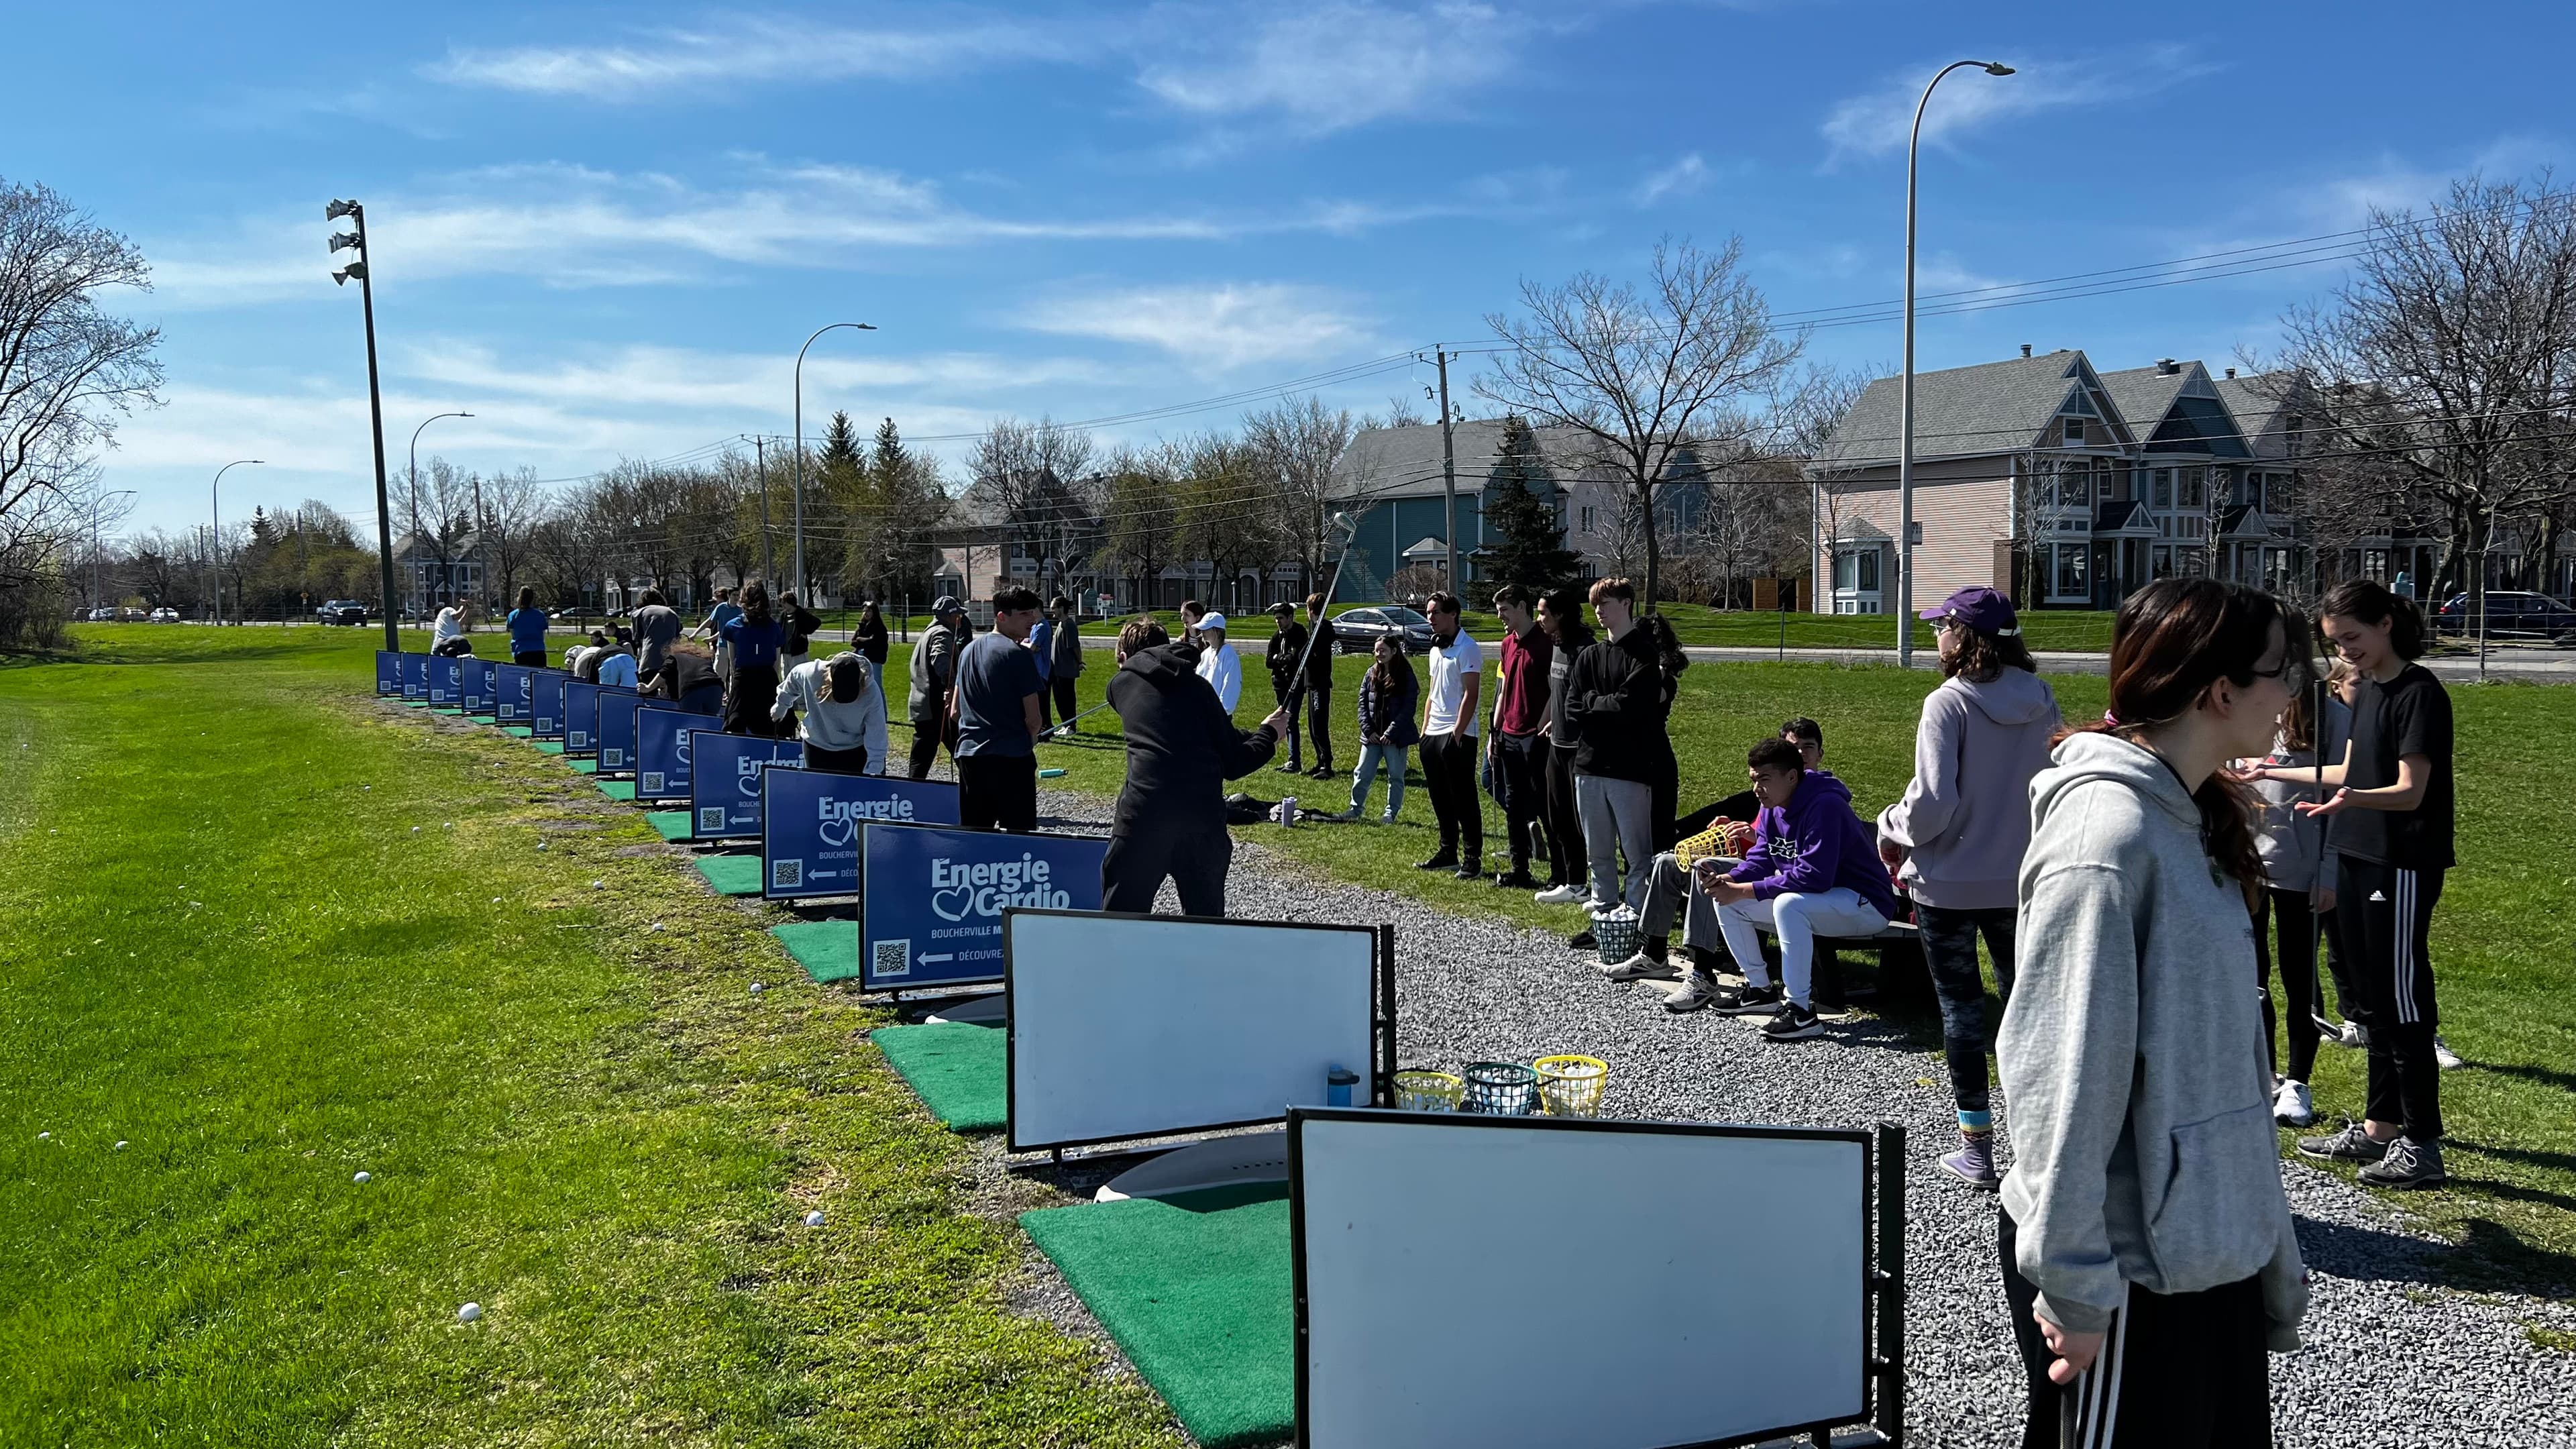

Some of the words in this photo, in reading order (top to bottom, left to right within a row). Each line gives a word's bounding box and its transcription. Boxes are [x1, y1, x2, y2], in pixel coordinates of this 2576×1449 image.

[975, 882, 1070, 916] Cardio
[931, 926, 991, 938] BOUCHERVILLE
[959, 949, 1004, 961] DÉCOUVRE
